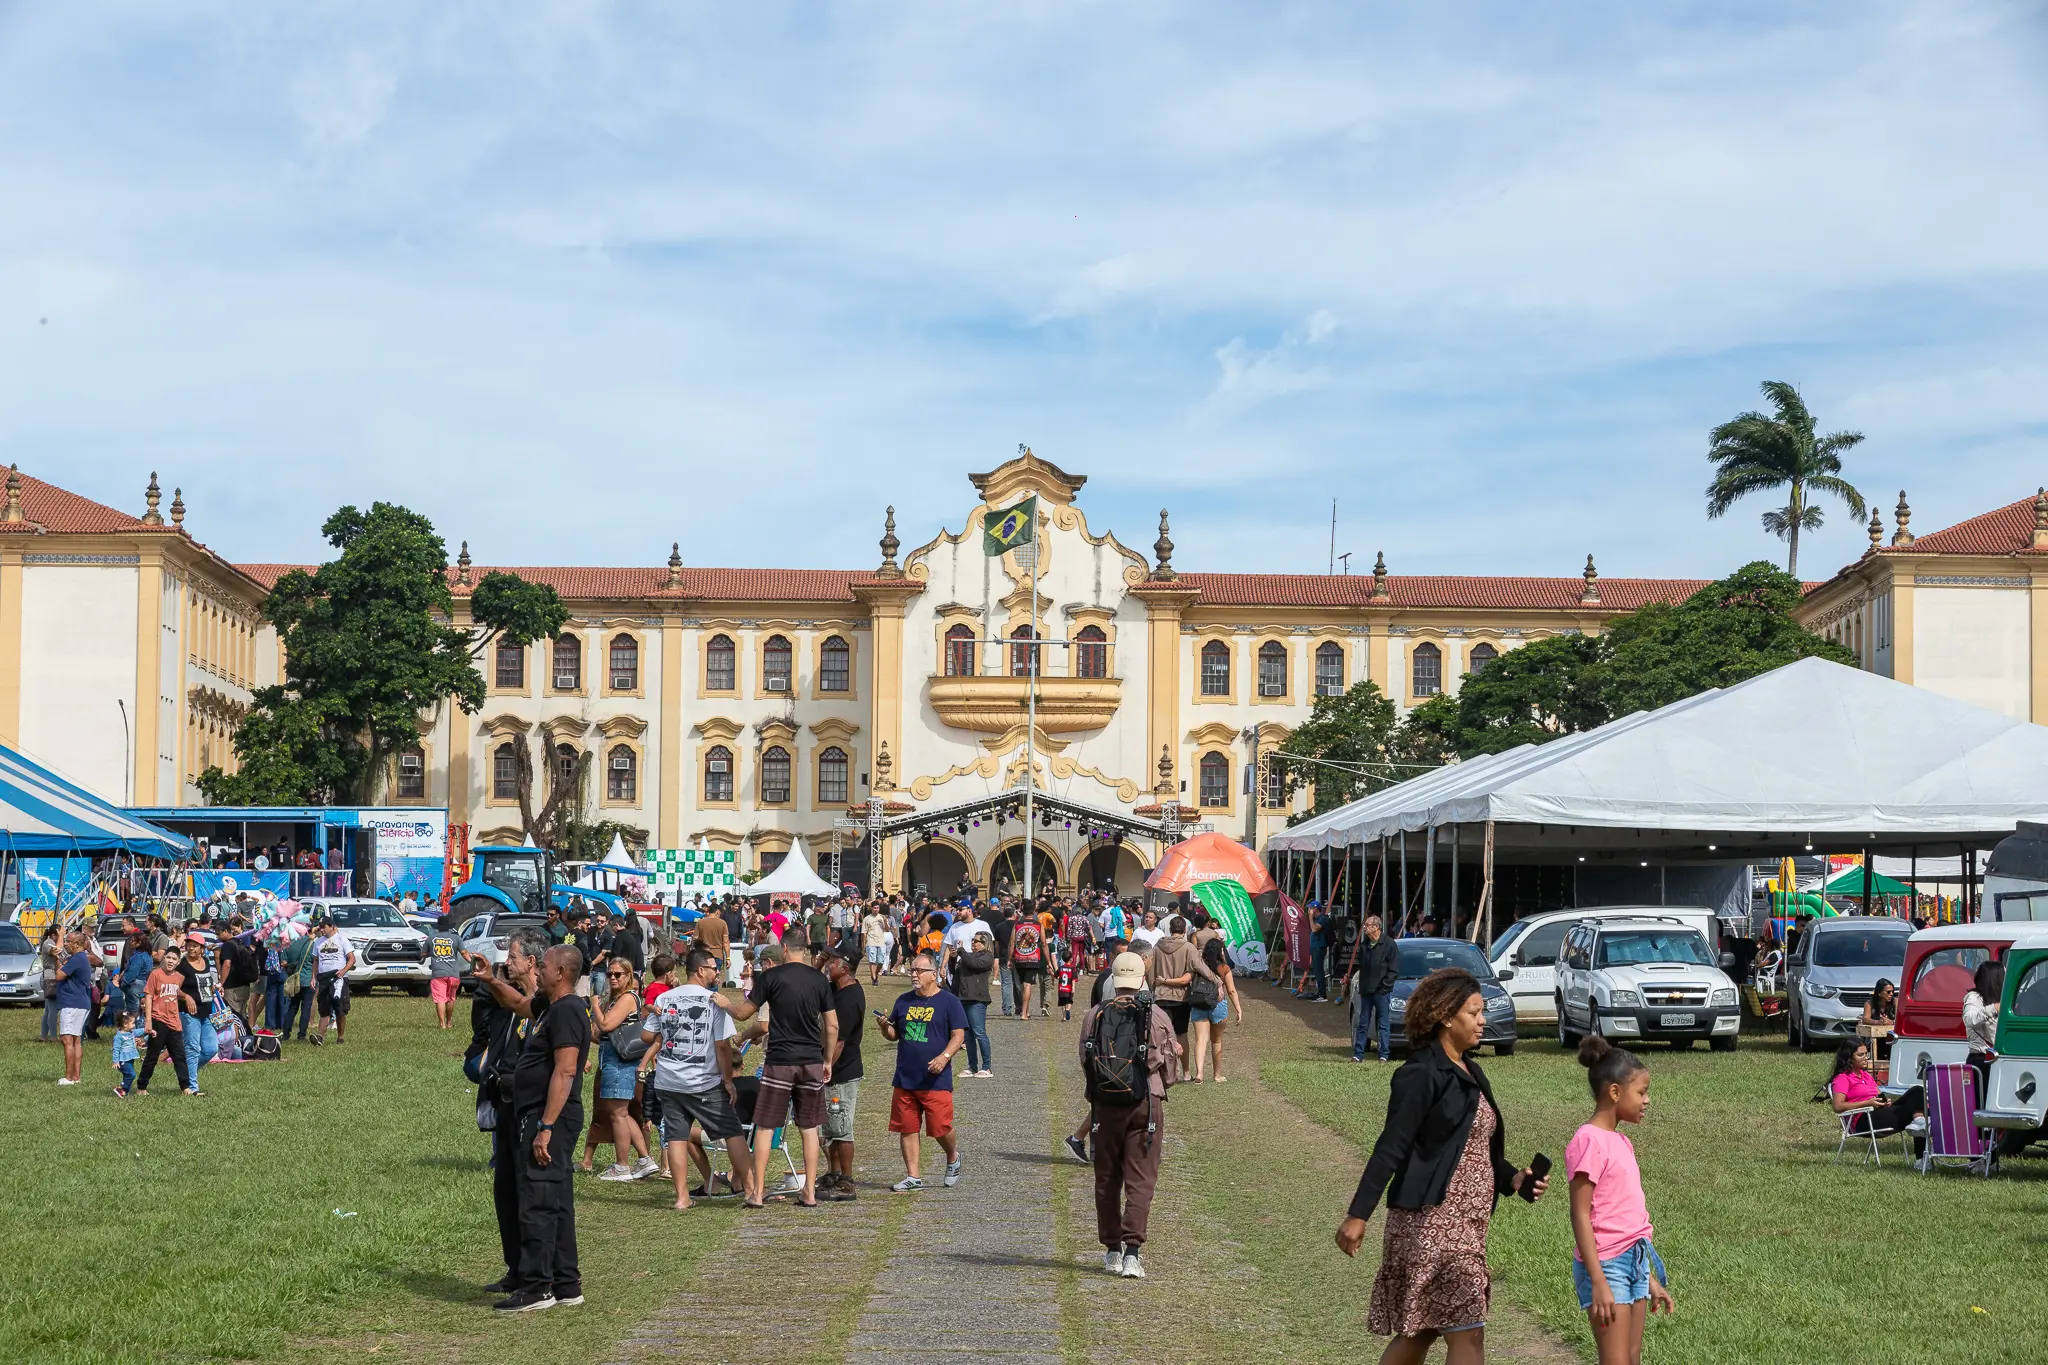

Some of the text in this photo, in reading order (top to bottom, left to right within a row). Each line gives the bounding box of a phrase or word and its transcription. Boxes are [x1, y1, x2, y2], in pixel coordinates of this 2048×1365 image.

[368, 820, 414, 829] Caravana
[378, 828, 414, 838] Ciência
[1190, 870, 1241, 881] Harmony
[1061, 973, 1068, 987] 9
[905, 1021, 928, 1042] SIL
